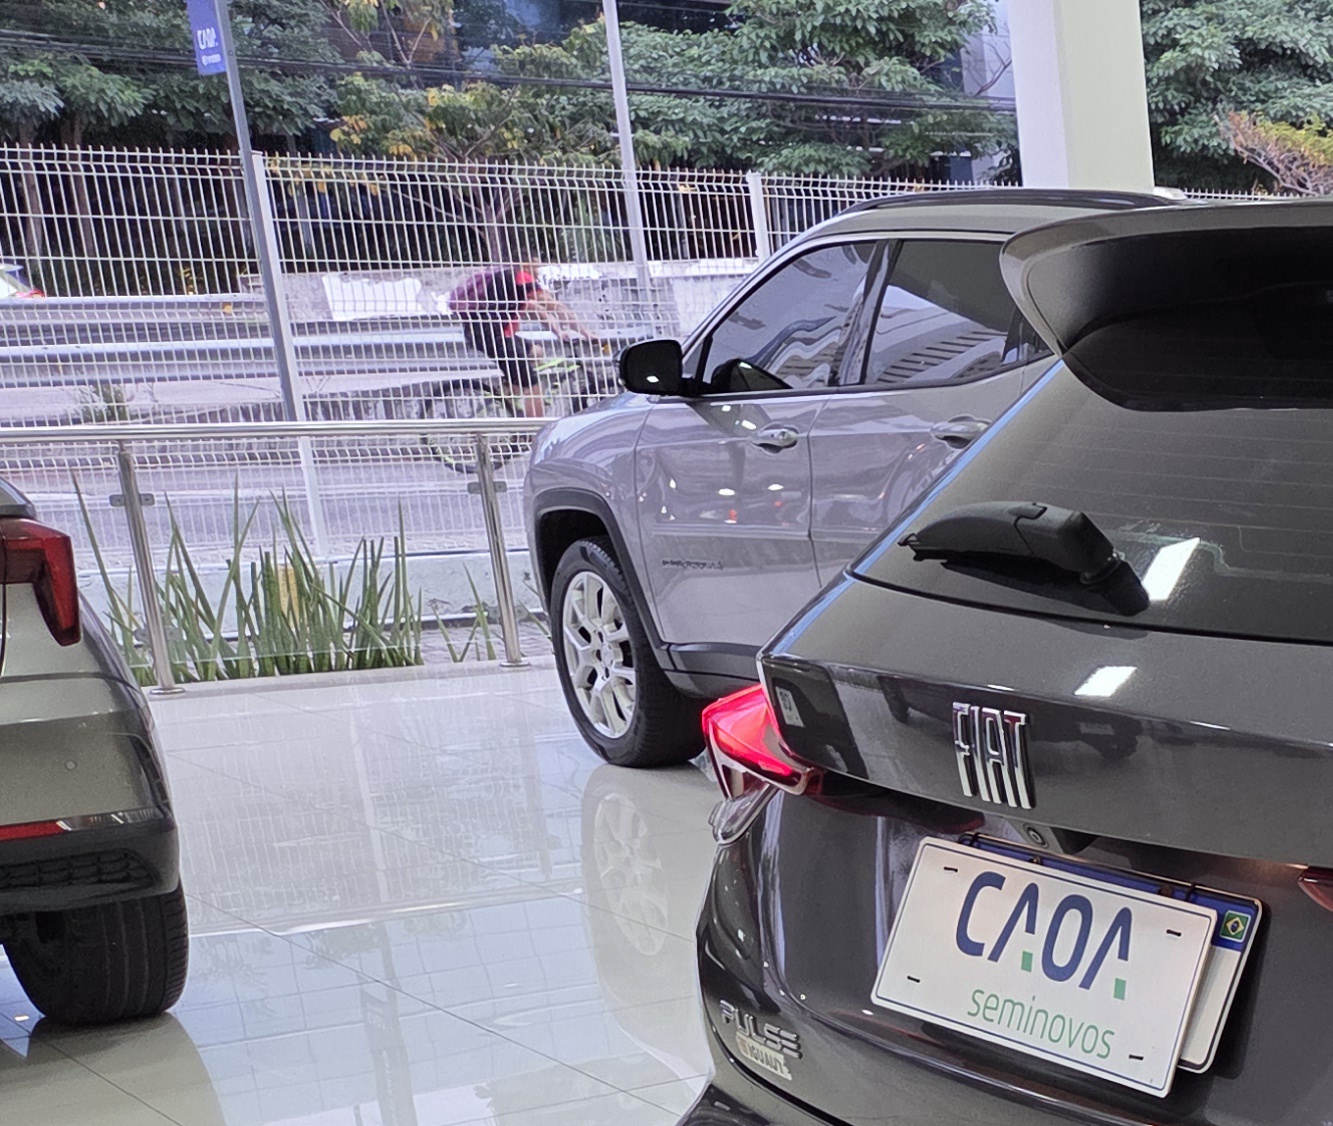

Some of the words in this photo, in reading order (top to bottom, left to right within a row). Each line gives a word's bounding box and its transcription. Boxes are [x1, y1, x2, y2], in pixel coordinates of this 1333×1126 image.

[952, 701, 1032, 810] FIAT
[956, 871, 1133, 1001] CAOA
[720, 999, 802, 1060] PULSE
[967, 989, 1115, 1059] seminovos
